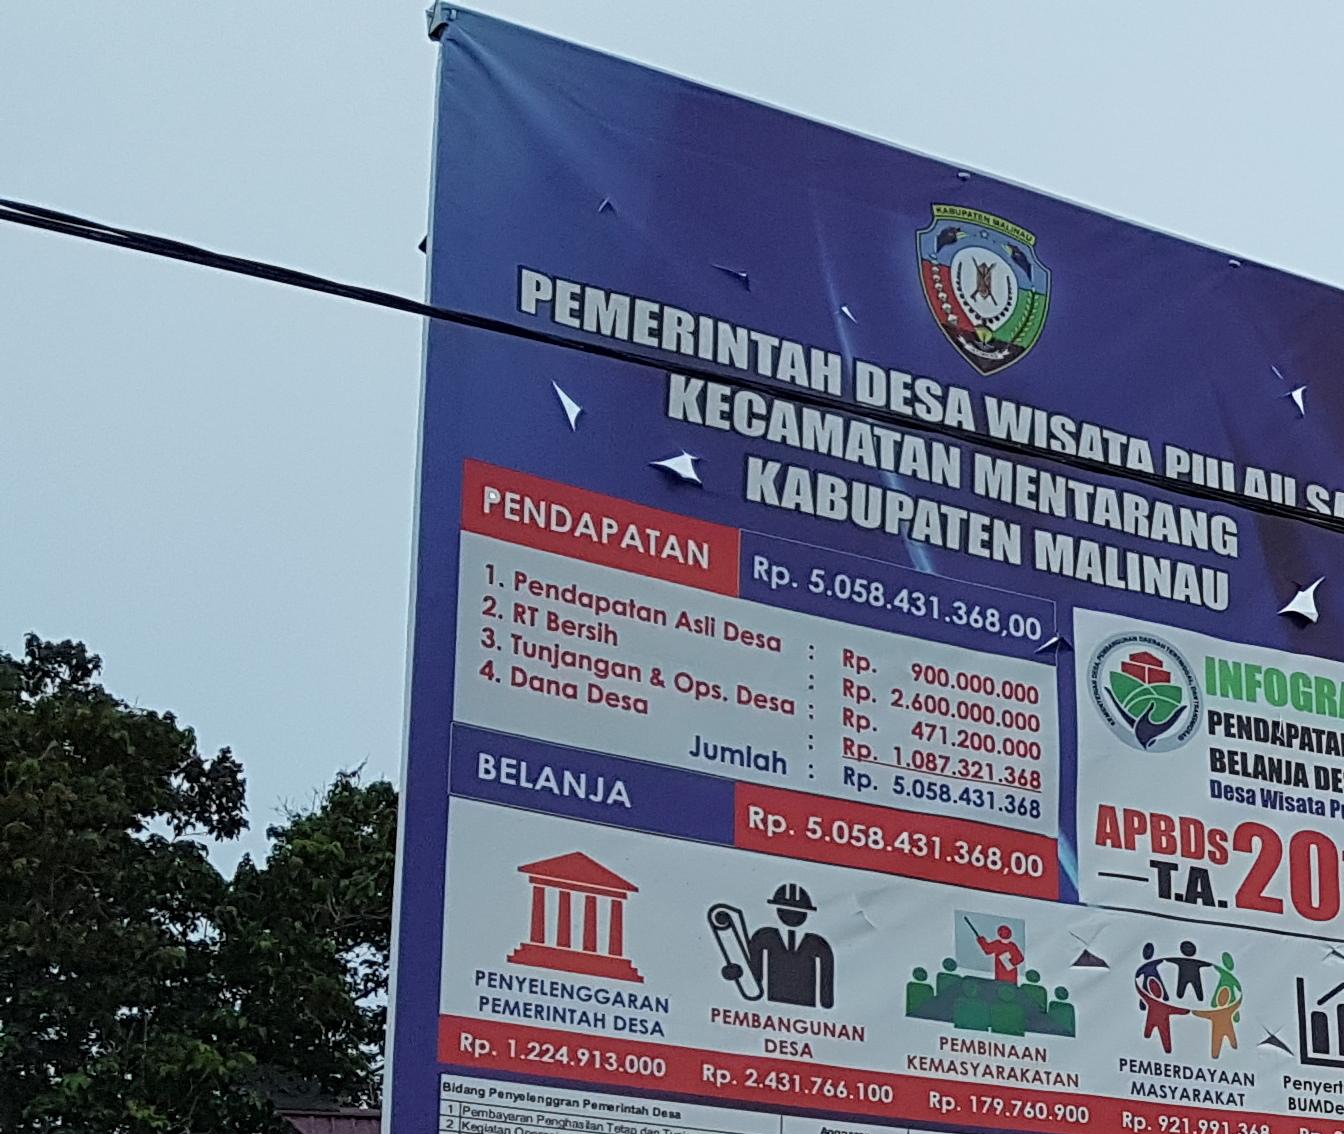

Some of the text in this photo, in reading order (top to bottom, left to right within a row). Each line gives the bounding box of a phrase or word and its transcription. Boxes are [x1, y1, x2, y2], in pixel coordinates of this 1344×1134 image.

[520, 268, 842, 396] PEMERINTAH
[855, 359, 975, 433] DESA
[984, 395, 1155, 478] WISATA
[668, 371, 1238, 560] KECAMATAN MENTARANG
[483, 485, 709, 569] PENDAPATAN
[745, 454, 1229, 614] KABUPATEN MALINAU
[753, 554, 1041, 641] Rp. 5.058.431.368,00
[485, 563, 1039, 705] 1. Pendapatan Asli Desa Rp. 900.000.000
[481, 594, 1040, 733] 2. RT Bersih Rp. 2.600.000.000
[480, 626, 1041, 761] 3. Tunjangan & Ops. Desa Rp. 471.200.000
[479, 659, 1042, 791] 4. Dana Desa Rp. 1.087.321.368
[478, 752, 631, 808] BELANJA
[688, 734, 1041, 820] Jumlah Rp. 5.058.431.368
[1209, 746, 1309, 789] BELANJA
[1209, 778, 1256, 806] Desa
[1259, 787, 1326, 817] Wisata
[748, 805, 1043, 877] Rp. 5.058.431.368,00
[1095, 803, 1229, 865] APBDs
[474, 969, 669, 1014] PENYELENGGARAN
[478, 995, 665, 1038] PEMERINTAH DESA
[710, 1007, 865, 1042] PEMBANGUNAN
[459, 1031, 666, 1077] Rp. 1.224.913.000
[763, 1037, 813, 1059] DESA
[938, 1035, 1047, 1063] PEMBINAAN
[702, 1064, 893, 1104] Rp. 2.431.766.100
[906, 1054, 1079, 1088] KEMASYARAKATAN
[1118, 1057, 1255, 1087] PEMBERDAYAAN
[1129, 1080, 1245, 1107] MASYARAKAT
[442, 1081, 486, 1099] Bidang
[582, 1098, 649, 1116] Pemerintah
[652, 1106, 682, 1120] Desa
[929, 1090, 1090, 1124] Rp. 179.760.900
[1121, 1110, 1152, 1131] Rp.
